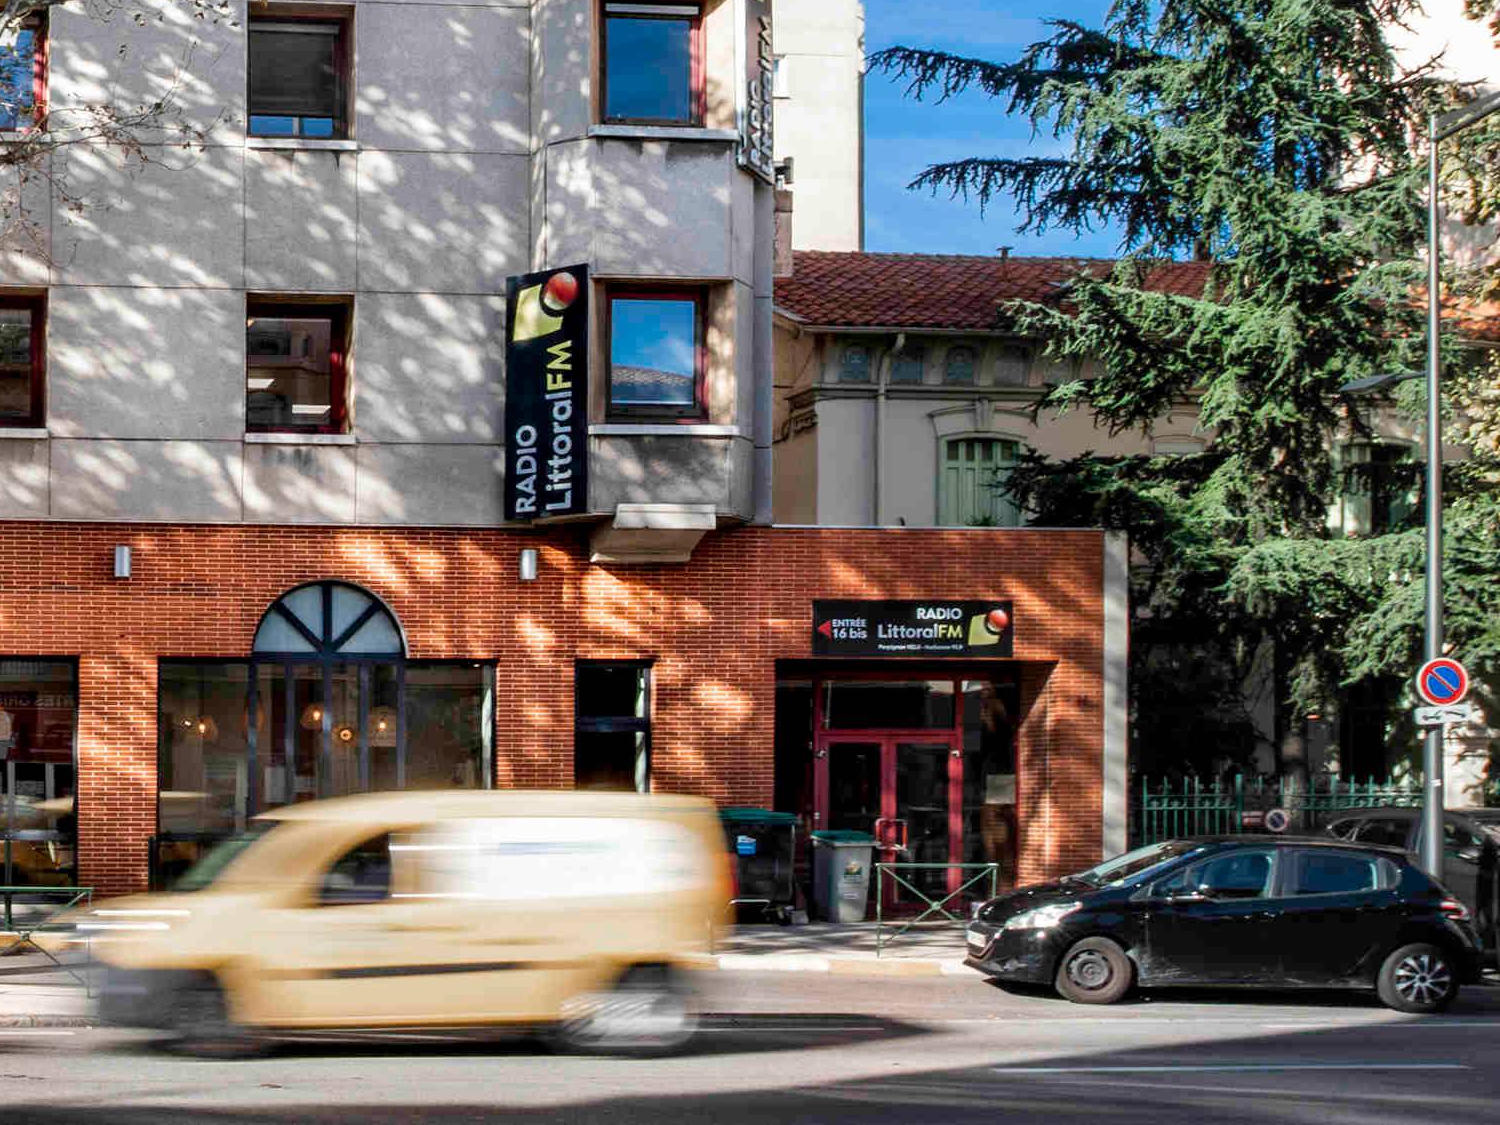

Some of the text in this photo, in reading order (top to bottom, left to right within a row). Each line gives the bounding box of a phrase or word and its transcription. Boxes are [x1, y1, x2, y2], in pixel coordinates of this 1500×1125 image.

[545, 339, 573, 511] LittoralFM
[515, 424, 538, 514] RADIO
[916, 607, 963, 620] RADIO
[832, 617, 867, 628] ENTRÉE
[832, 628, 868, 639] 16 bis
[877, 623, 963, 639] LittoralFM
